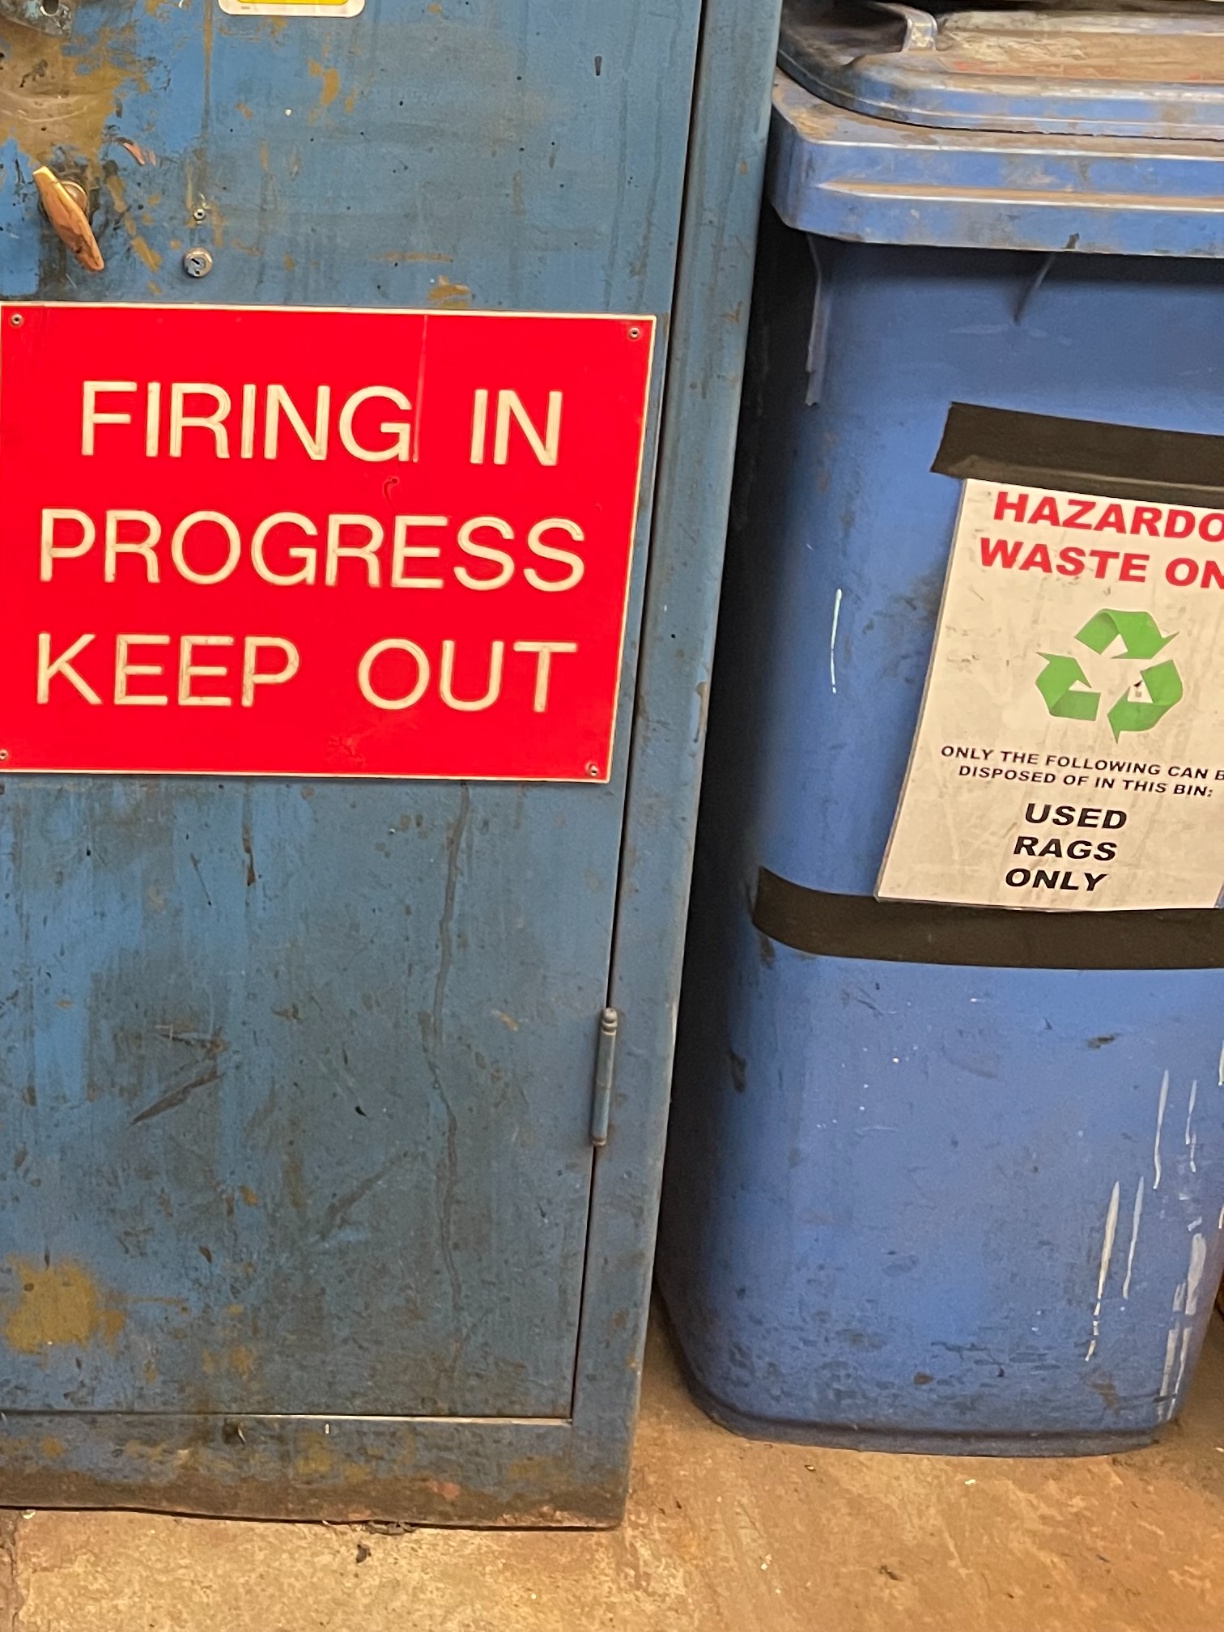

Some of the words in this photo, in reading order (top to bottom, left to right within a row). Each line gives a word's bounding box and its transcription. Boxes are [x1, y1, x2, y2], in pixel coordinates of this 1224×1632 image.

[81, 379, 413, 462] FIRING
[469, 388, 563, 466] IN
[993, 490, 1224, 543] HAZARDO
[39, 507, 585, 592] PROGRESS
[979, 536, 1151, 584] WASTE
[1164, 557, 1224, 590] ON
[36, 632, 301, 708] KEEP
[356, 637, 578, 715] OUT
[941, 745, 994, 762] ONLY
[999, 750, 1040, 765] THE
[1045, 755, 1161, 776] FOLLOWING
[1167, 765, 1209, 780] CAN
[958, 765, 1057, 784] DISPOSED
[1062, 774, 1089, 786] OF
[1094, 777, 1116, 790] IN
[1122, 779, 1167, 794] THIS
[1173, 784, 1214, 798] BIN:
[1025, 802, 1128, 830] USED
[1012, 835, 1118, 862] RAGS
[1004, 867, 1109, 892] ONLY
